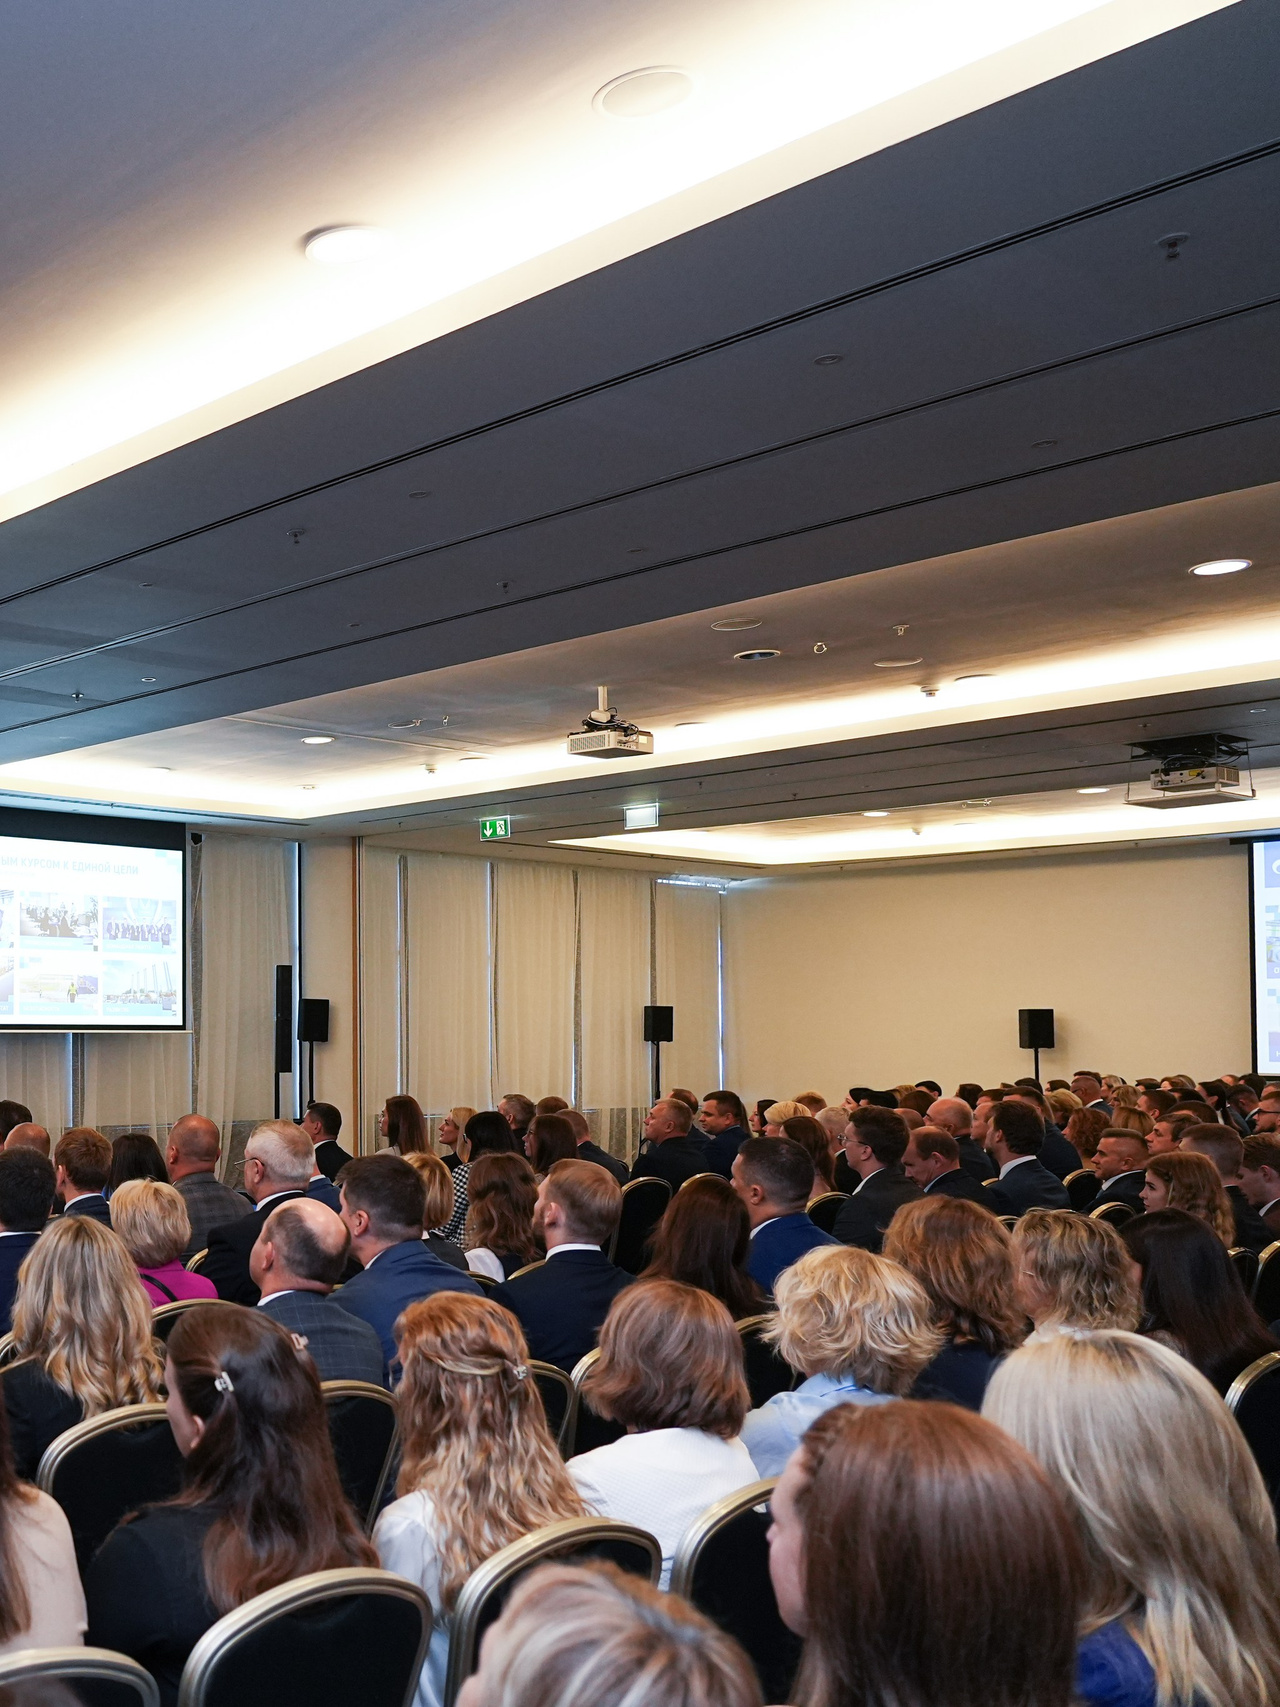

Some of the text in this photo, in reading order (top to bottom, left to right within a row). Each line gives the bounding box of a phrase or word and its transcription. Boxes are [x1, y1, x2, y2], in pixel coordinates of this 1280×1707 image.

[21, 858, 60, 869] КУРСОМ
[63, 861, 69, 870] К
[72, 861, 111, 873] ЕДИНОЙ
[113, 864, 139, 875] ЦЕЛИ
